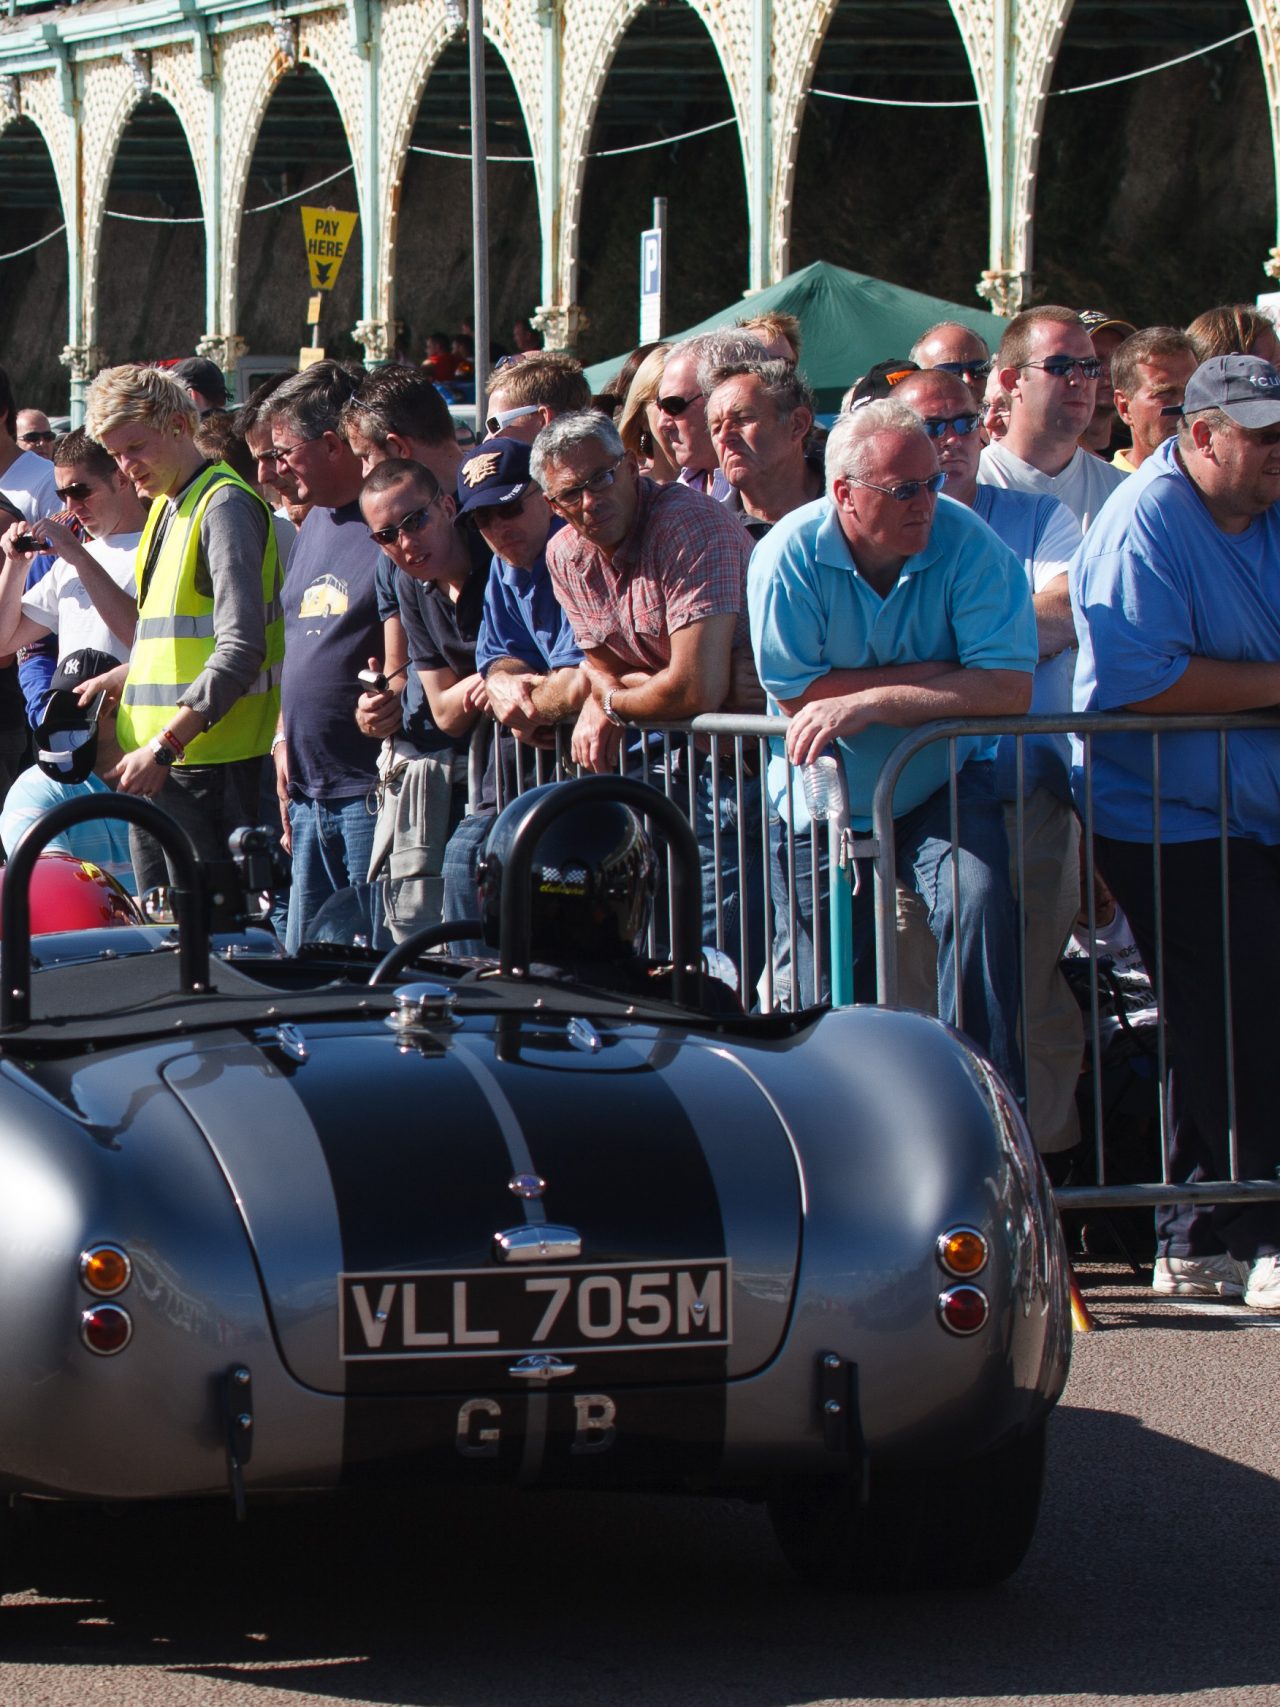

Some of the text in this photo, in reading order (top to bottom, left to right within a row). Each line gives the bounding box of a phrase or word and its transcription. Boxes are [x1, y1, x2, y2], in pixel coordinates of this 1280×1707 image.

[315, 218, 340, 236] PAY
[308, 238, 344, 258] HERE
[645, 238, 658, 292] P
[1249, 375, 1280, 387] fcu
[351, 1269, 722, 1348] VLL 705M
